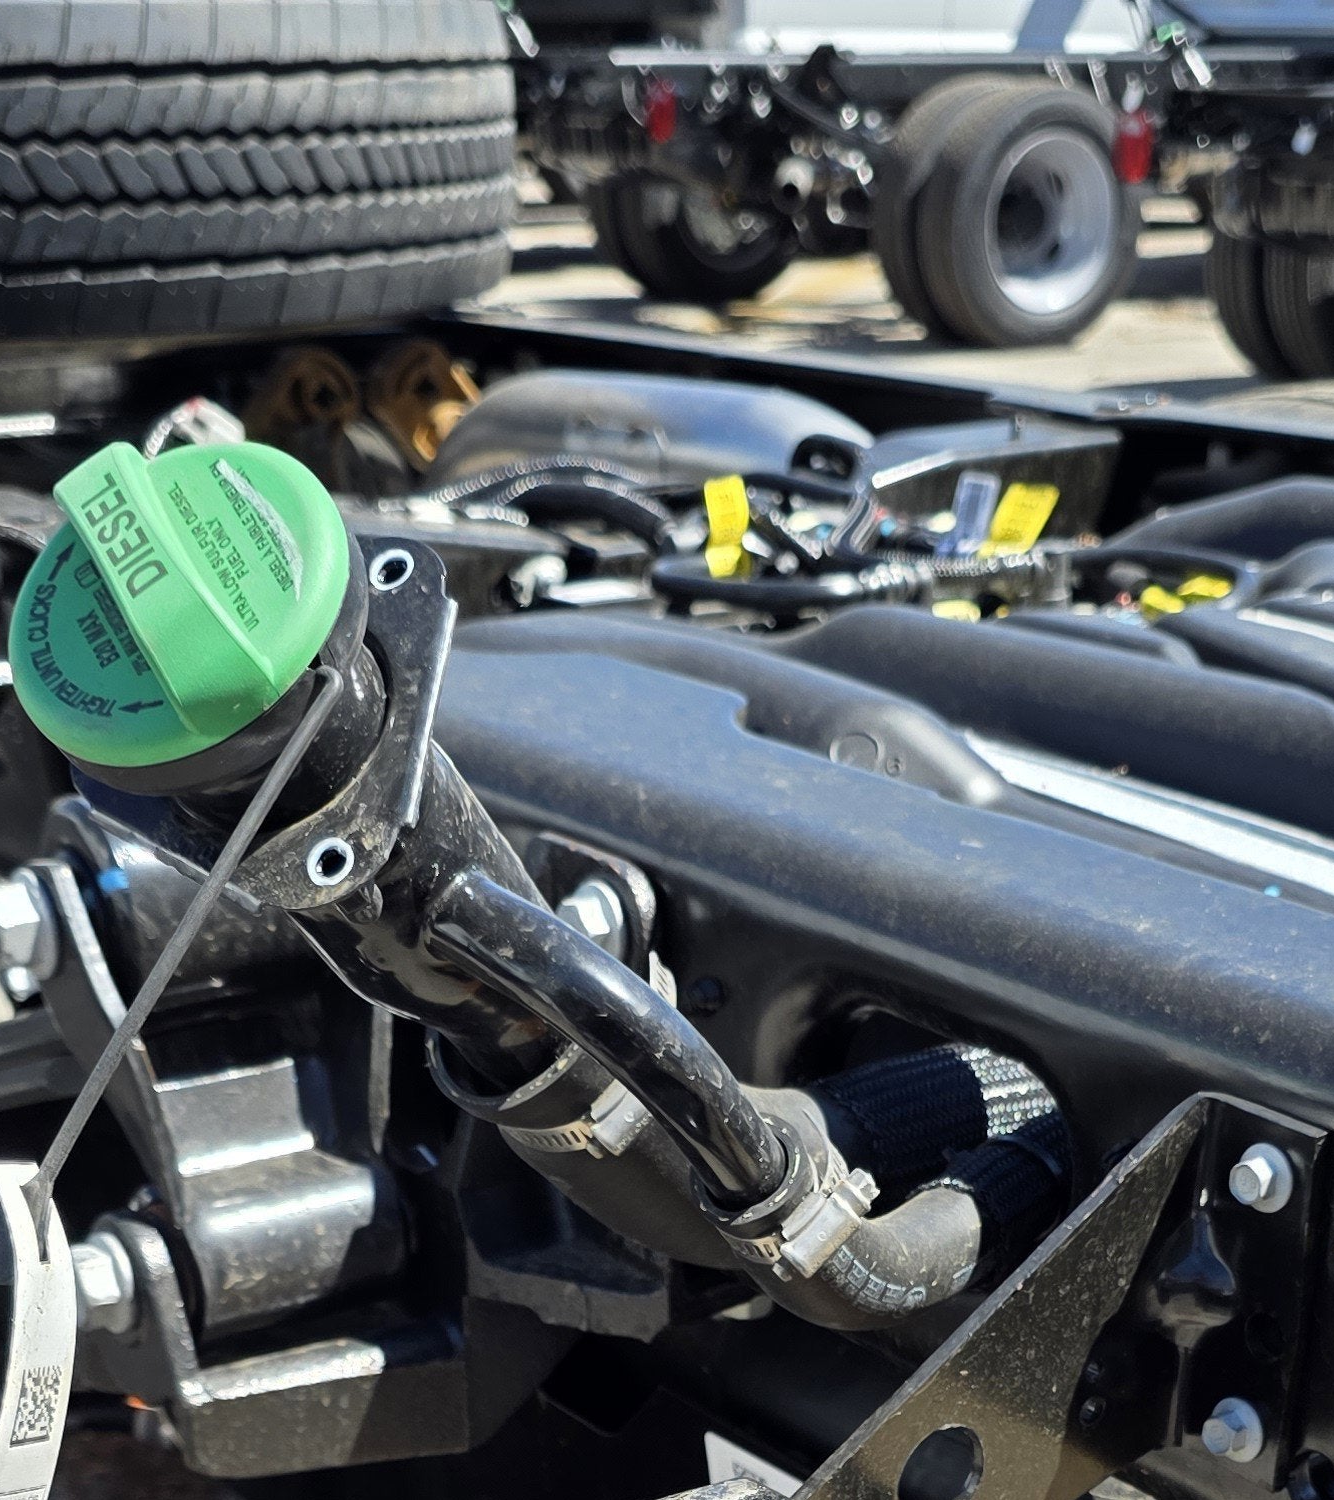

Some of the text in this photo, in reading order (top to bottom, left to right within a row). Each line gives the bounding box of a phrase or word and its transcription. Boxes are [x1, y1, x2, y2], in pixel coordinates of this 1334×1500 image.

[80, 471, 169, 600] DIESEL
[168, 480, 260, 633] ULTRA LOW SULFUR DIESEL
[205, 516, 250, 581] FUEL ONLY
[241, 512, 270, 552] FAIBLE
[268, 553, 294, 593] DIESEL
[27, 583, 117, 718] TIGHTEN UNTIL CLICKS
[76, 608, 121, 670] B20 MAX
